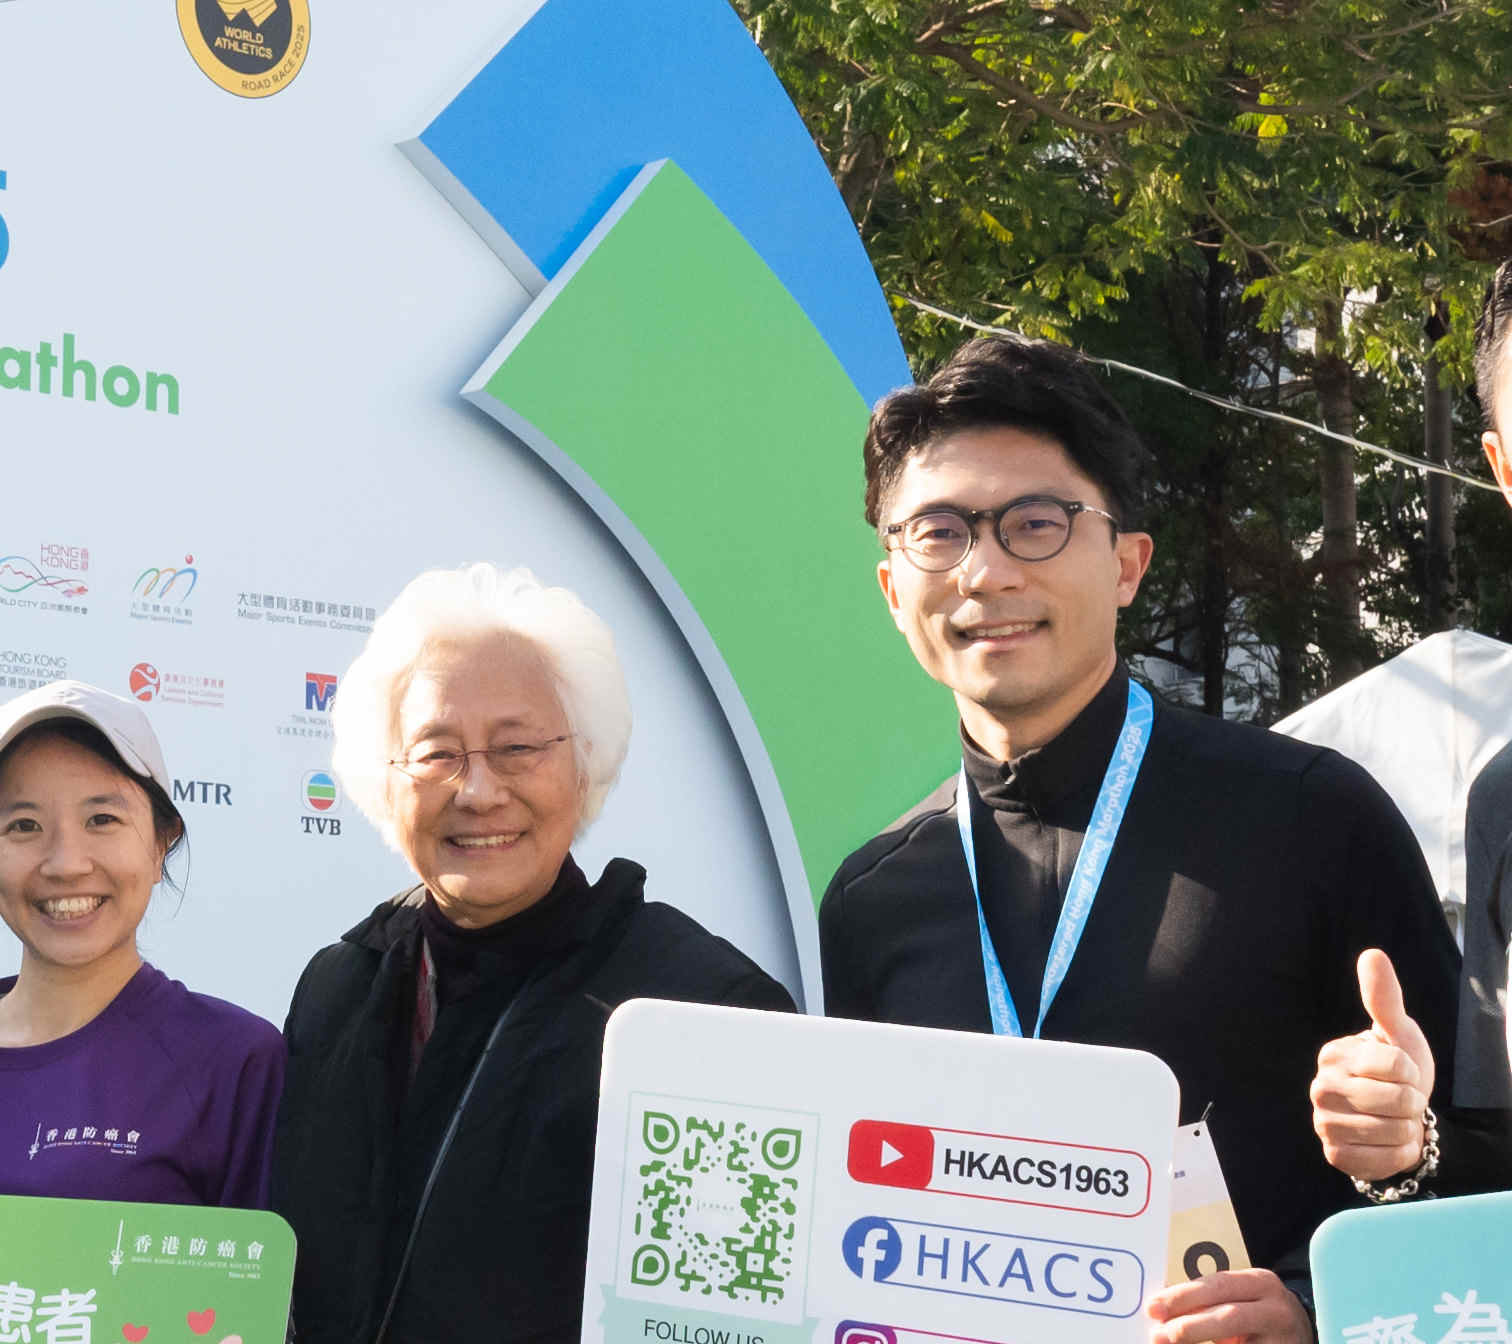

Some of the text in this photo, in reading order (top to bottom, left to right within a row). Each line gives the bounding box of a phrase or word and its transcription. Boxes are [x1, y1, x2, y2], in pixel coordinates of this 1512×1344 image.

[224, 24, 264, 45] WORLD
[213, 36, 274, 61] ATHLETICS
[40, 543, 80, 558] HONG
[40, 556, 80, 570] KONG
[34, 653, 68, 669] KONG
[173, 778, 233, 806] MTR
[300, 816, 342, 836] TVB
[943, 1146, 1131, 1199] HKACS1963
[134, 1234, 265, 1261] 香港防癌會
[915, 1233, 1117, 1305] HKACS
